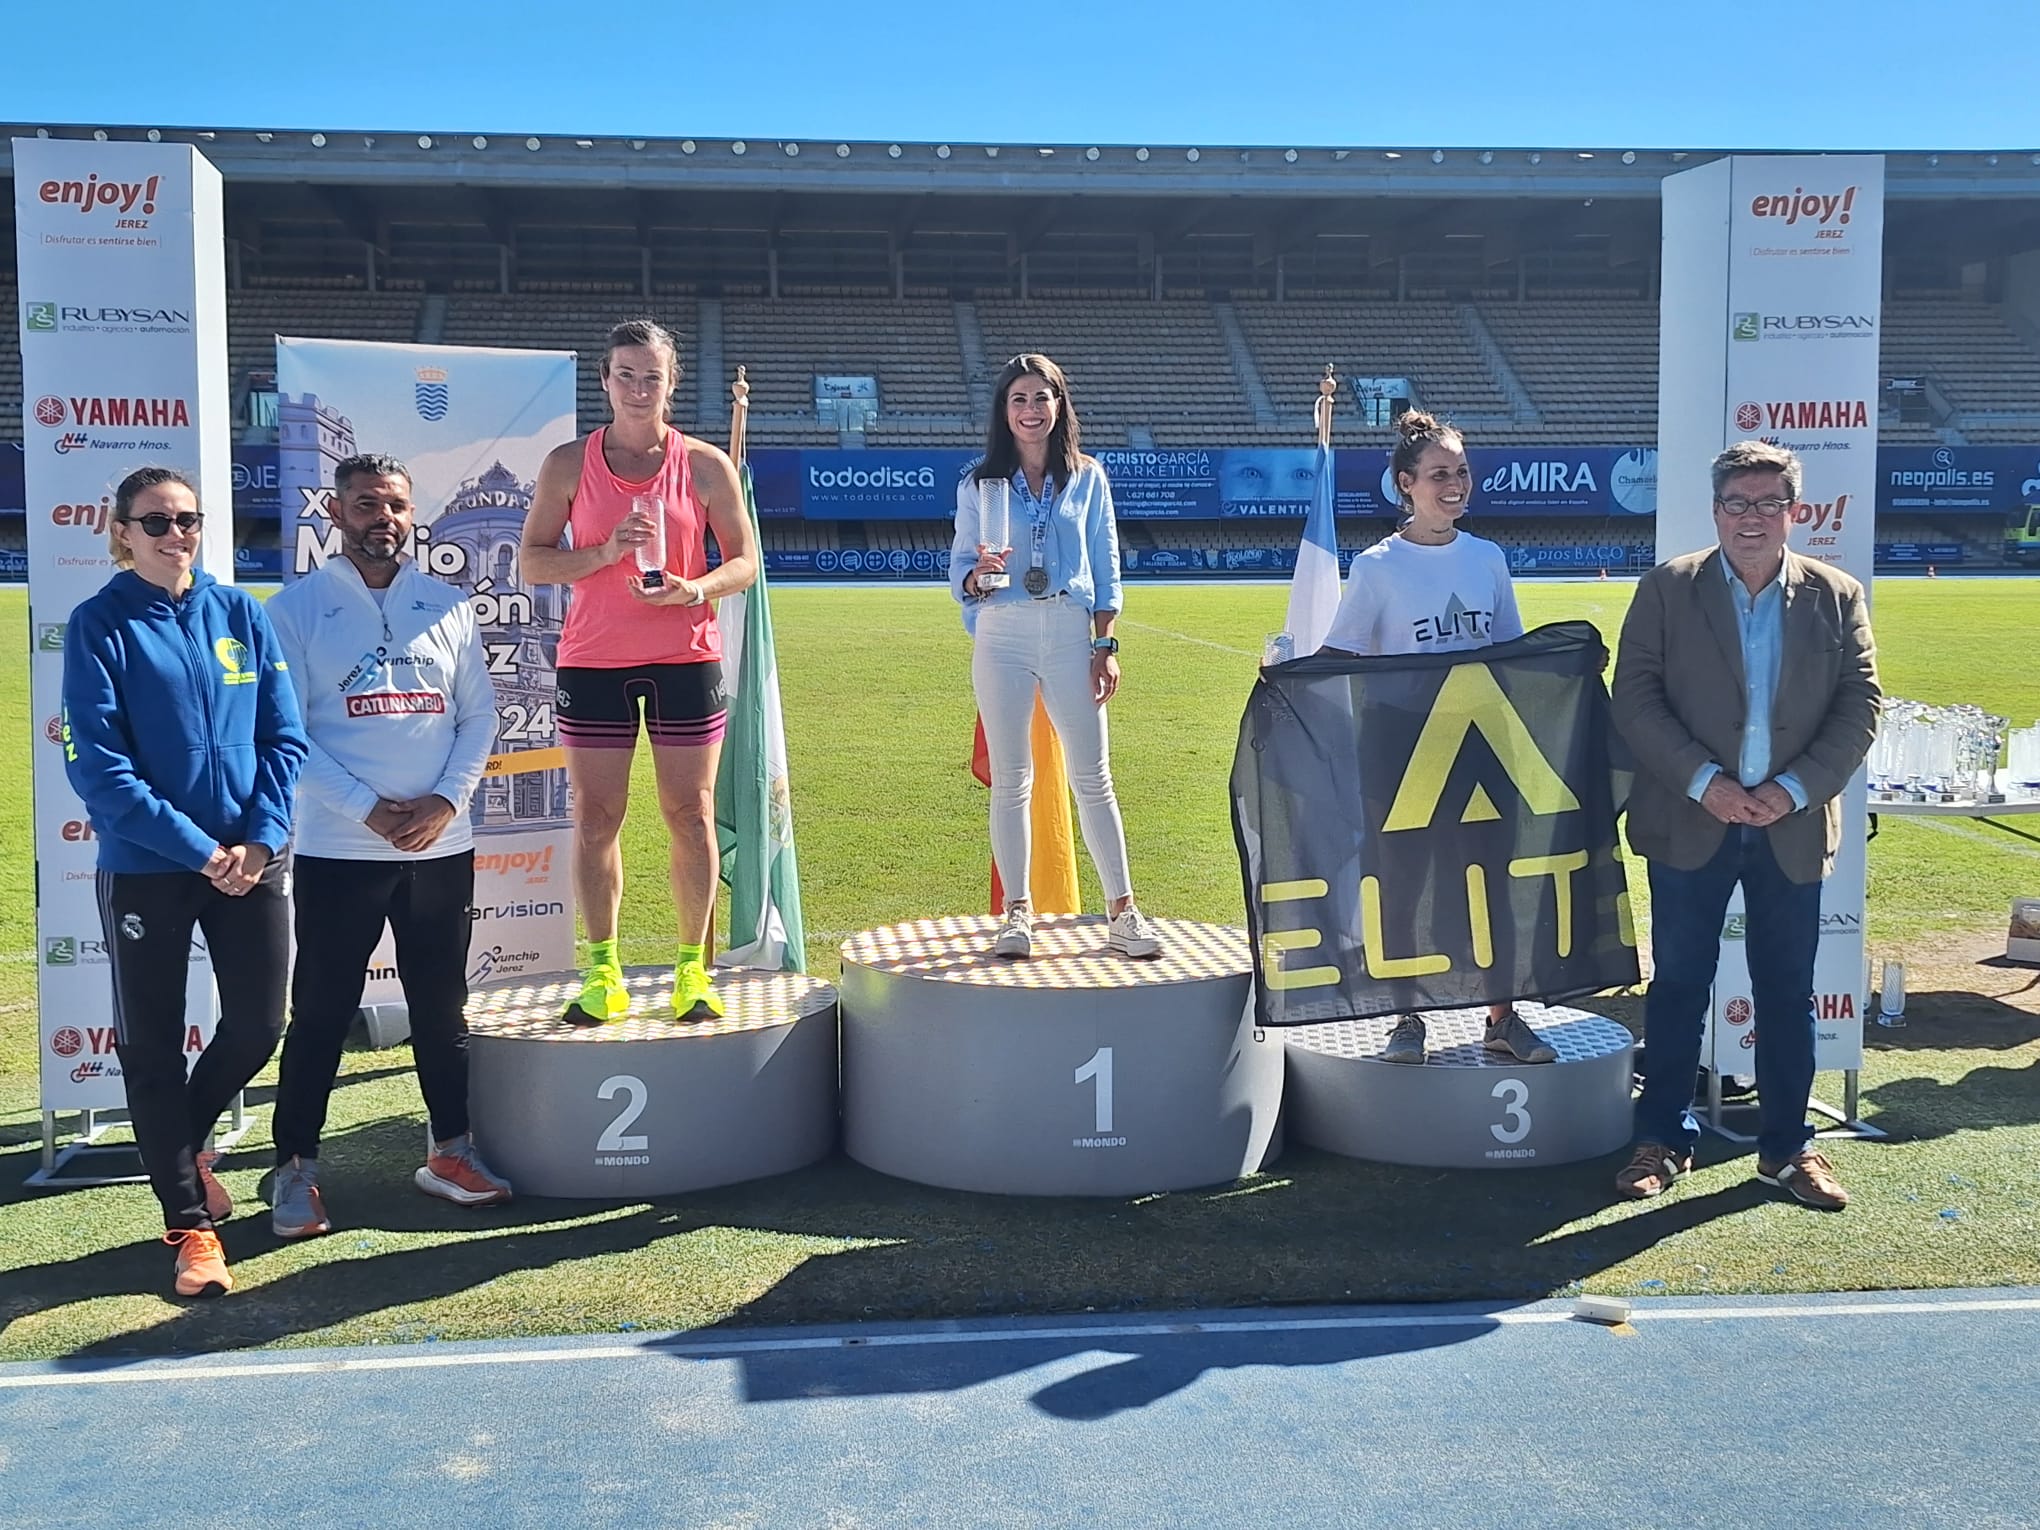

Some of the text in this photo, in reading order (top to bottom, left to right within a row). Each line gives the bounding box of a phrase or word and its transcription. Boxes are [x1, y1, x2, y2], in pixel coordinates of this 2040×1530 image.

[40, 174, 159, 215] enjoy!
[1752, 187, 1856, 225] enjoy!
[115, 219, 149, 229] JEREZ
[45, 234, 85, 244] Disfrutar
[99, 235, 135, 245] sentirse
[137, 236, 157, 246] bien
[1815, 230, 1844, 239] JEREZ
[61, 307, 189, 324] RUBYSAN
[1764, 315, 1874, 329] RUBYSAN
[70, 397, 190, 427] YAMAHA
[1766, 401, 1868, 429] YAMAHA
[90, 439, 172, 451] Navarro Hnos.
[1782, 442, 1851, 451] Navarro Hnos.
[1106, 449, 1210, 465] CRISTOGARCÍA
[1106, 465, 1210, 477] MARKETING
[1482, 461, 1598, 492] elMIRA
[1891, 468, 1994, 492] neopolis.es
[1796, 494, 1848, 532] oy!
[1807, 537, 1836, 546] JEREZ
[1575, 546, 1623, 560] BACO
[58, 557, 97, 567] Disfrutar
[473, 576, 533, 626] ón
[495, 703, 556, 741] 24
[485, 760, 502, 772] RD!
[473, 845, 554, 875] enjoy!
[66, 871, 97, 881] Disfrut
[471, 899, 564, 921] arvision
[1074, 1047, 1113, 1133] 1
[597, 1074, 649, 1151] 2
[1490, 1079, 1532, 1144] 3
[1082, 1137, 1127, 1148] MONDO
[604, 1155, 649, 1166] MONDO
[1493, 1148, 1536, 1159] MONDO
